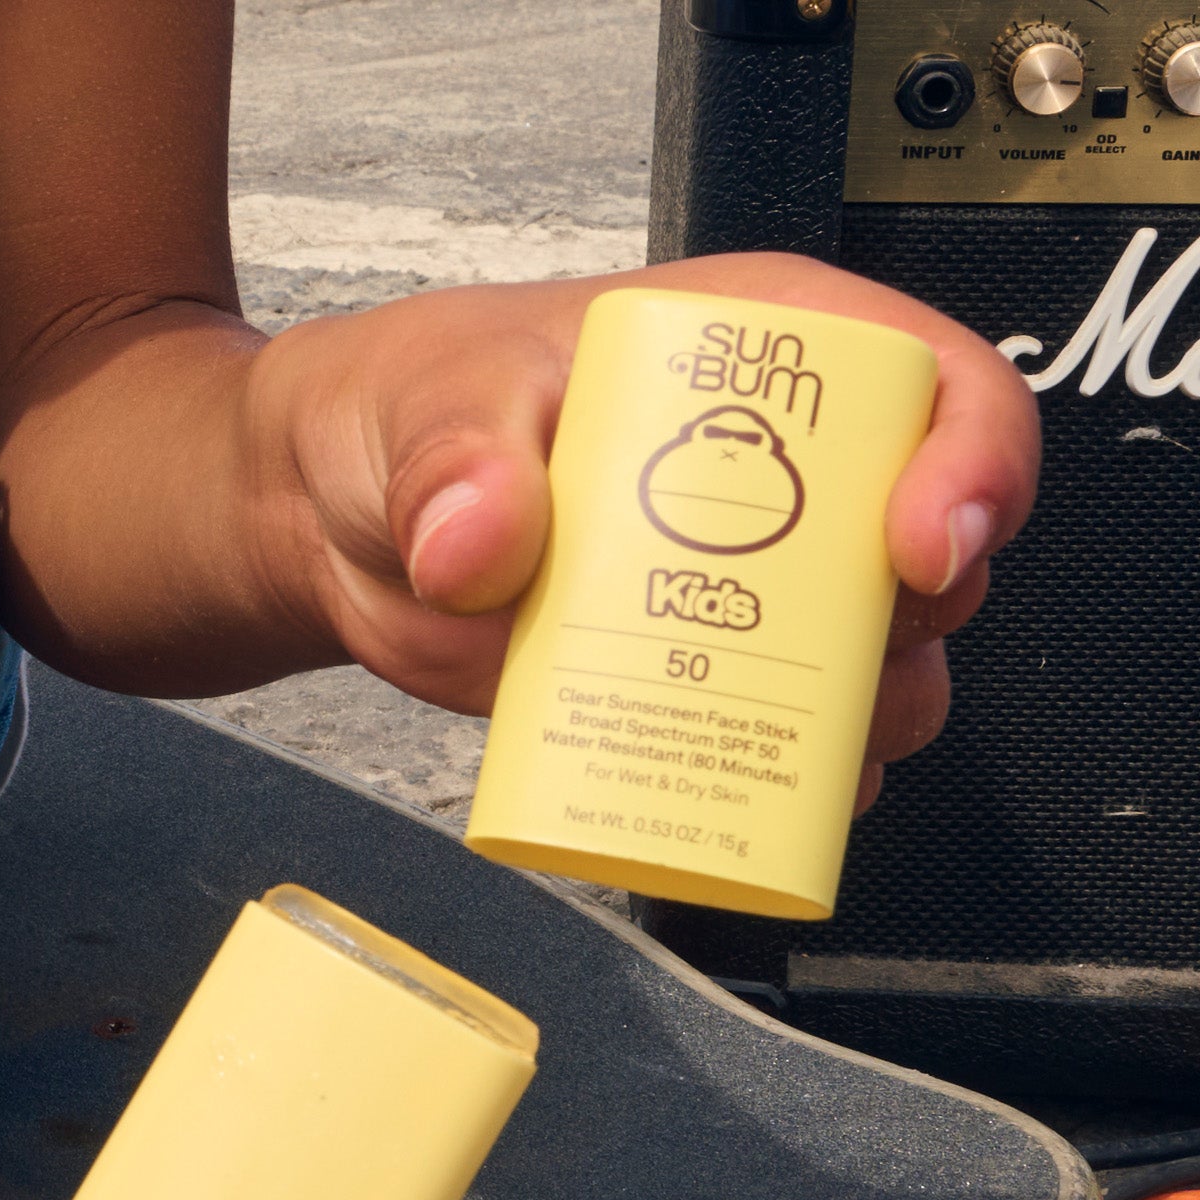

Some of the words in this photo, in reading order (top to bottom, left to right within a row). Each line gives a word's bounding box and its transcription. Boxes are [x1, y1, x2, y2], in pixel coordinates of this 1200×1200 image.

[993, 124, 1001, 133] 0
[1062, 124, 1078, 133] 10
[1096, 135, 1117, 145] OD
[1143, 125, 1151, 134] 0
[902, 146, 965, 159] INPUT
[1000, 149, 1066, 160] VOLUME
[1085, 146, 1127, 154] SELECT
[646, 568, 761, 631] Kids
[665, 649, 710, 682] 50
[558, 687, 603, 707] Clear
[607, 694, 702, 724] Sunscreen
[706, 711, 750, 732] Face
[753, 719, 799, 742] Stick
[569, 711, 622, 732] Broad
[625, 720, 714, 748] Spectrum
[717, 736, 754, 755] SPF
[757, 743, 780, 761] 50
[542, 729, 594, 750] Water
[599, 737, 684, 765] Resistant
[688, 753, 716, 770] (80
[719, 759, 798, 790] Minutes)
[585, 762, 613, 780] For
[618, 768, 652, 788] Wet
[657, 774, 670, 791] &
[675, 779, 706, 799] Dry
[710, 785, 750, 806] Skin
[564, 806, 596, 824] Net
[600, 812, 628, 830] Wt.
[633, 817, 673, 838] 0.53
[675, 825, 700, 843] OZ
